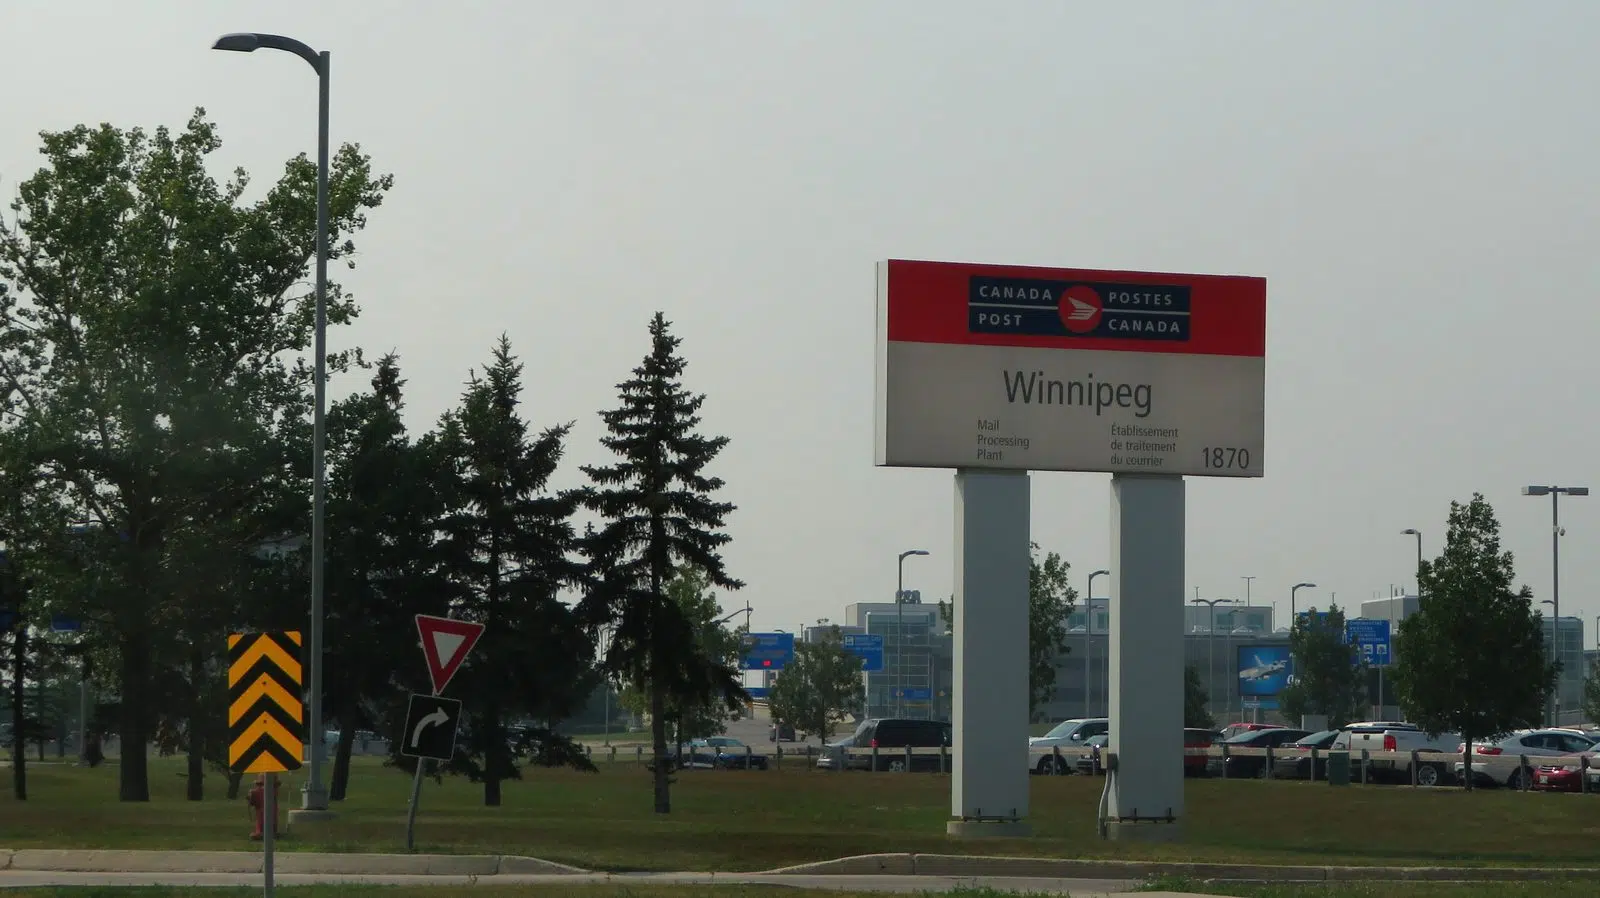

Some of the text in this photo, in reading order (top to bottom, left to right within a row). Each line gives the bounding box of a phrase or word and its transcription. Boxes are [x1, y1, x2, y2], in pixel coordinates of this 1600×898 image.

[979, 285, 1052, 300] CANADA
[1109, 292, 1172, 305] POSTES
[979, 313, 1023, 326] POST
[1108, 319, 1180, 333] CANADA
[1003, 370, 1152, 418] Winnipeg
[977, 419, 999, 430] Mail
[1111, 423, 1179, 437] Établissement
[977, 435, 1030, 449] Processing
[1110, 439, 1176, 452] de traitement
[977, 449, 1002, 460] Plant
[1110, 453, 1163, 466] du courrier
[1202, 446, 1250, 469] 1870
